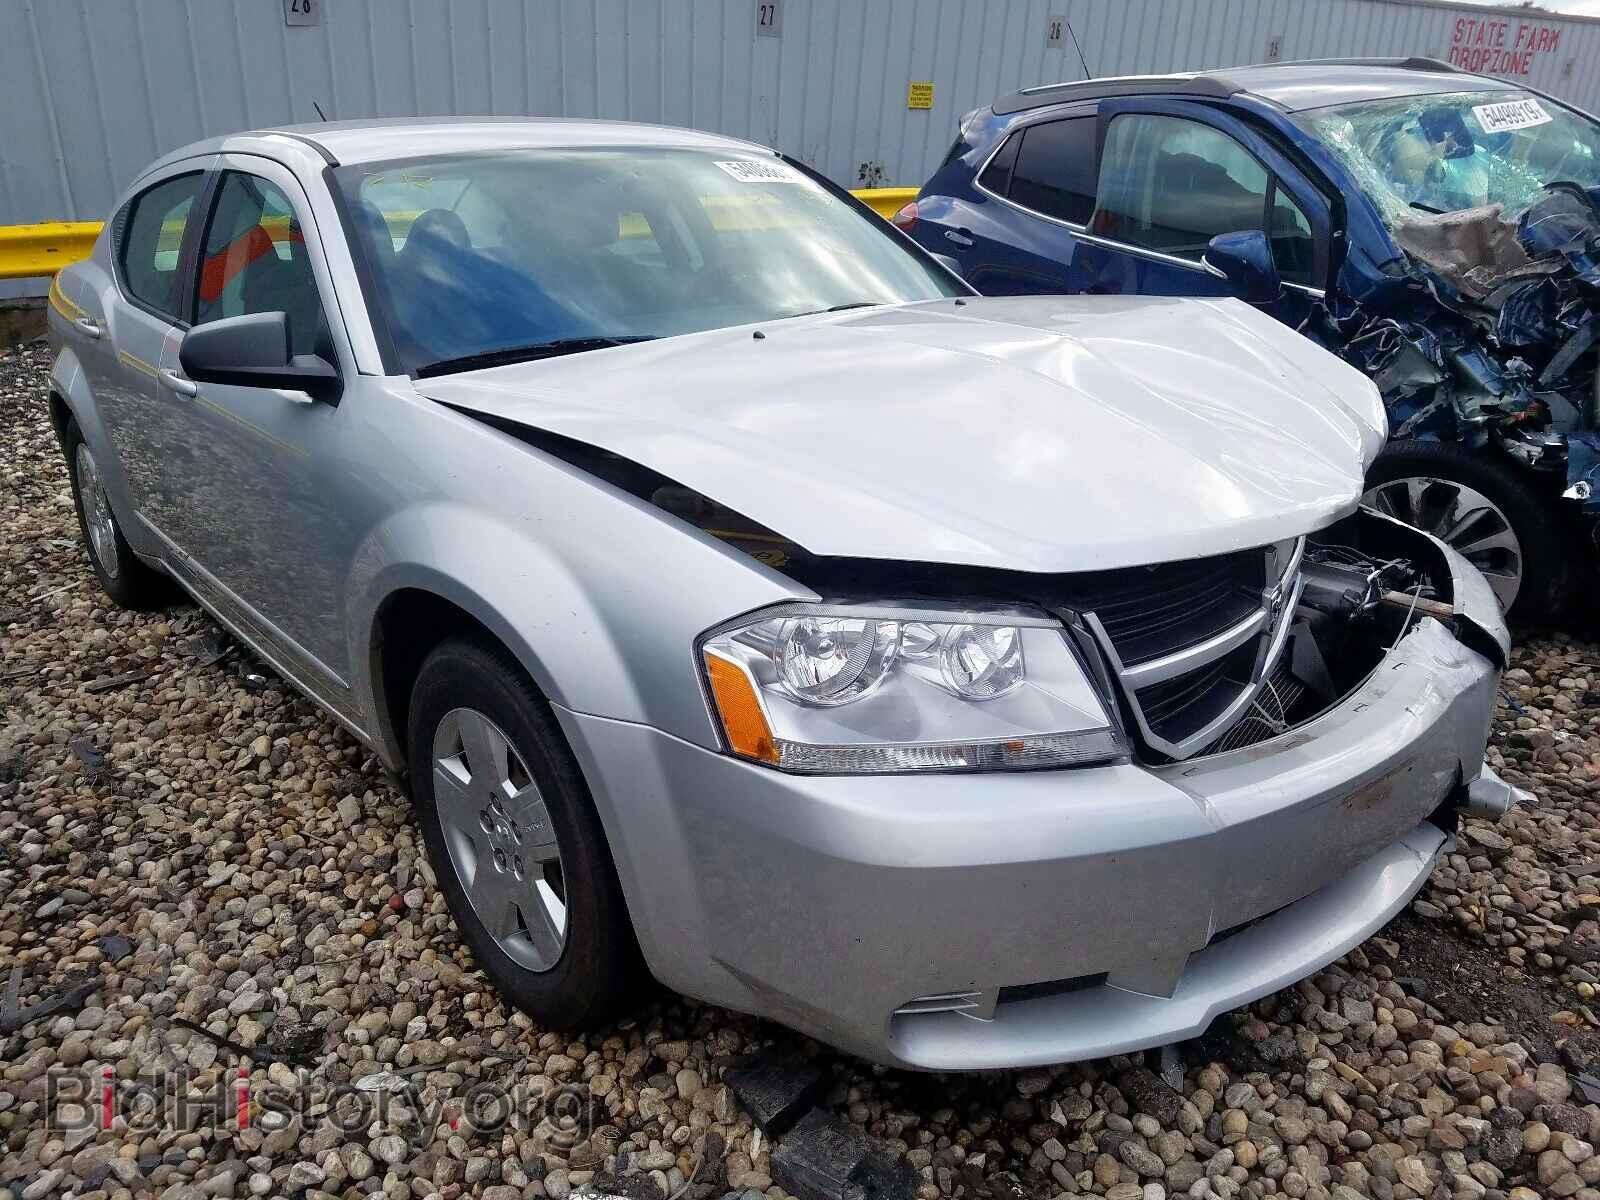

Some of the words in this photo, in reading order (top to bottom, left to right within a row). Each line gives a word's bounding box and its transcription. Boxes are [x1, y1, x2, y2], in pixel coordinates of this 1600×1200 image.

[760, 5, 775, 26] 27
[1050, 22, 1061, 40] 26
[1453, 18, 1508, 47] STATE
[1515, 24, 1561, 53] FARM
[1449, 46, 1533, 75] DROPZONE
